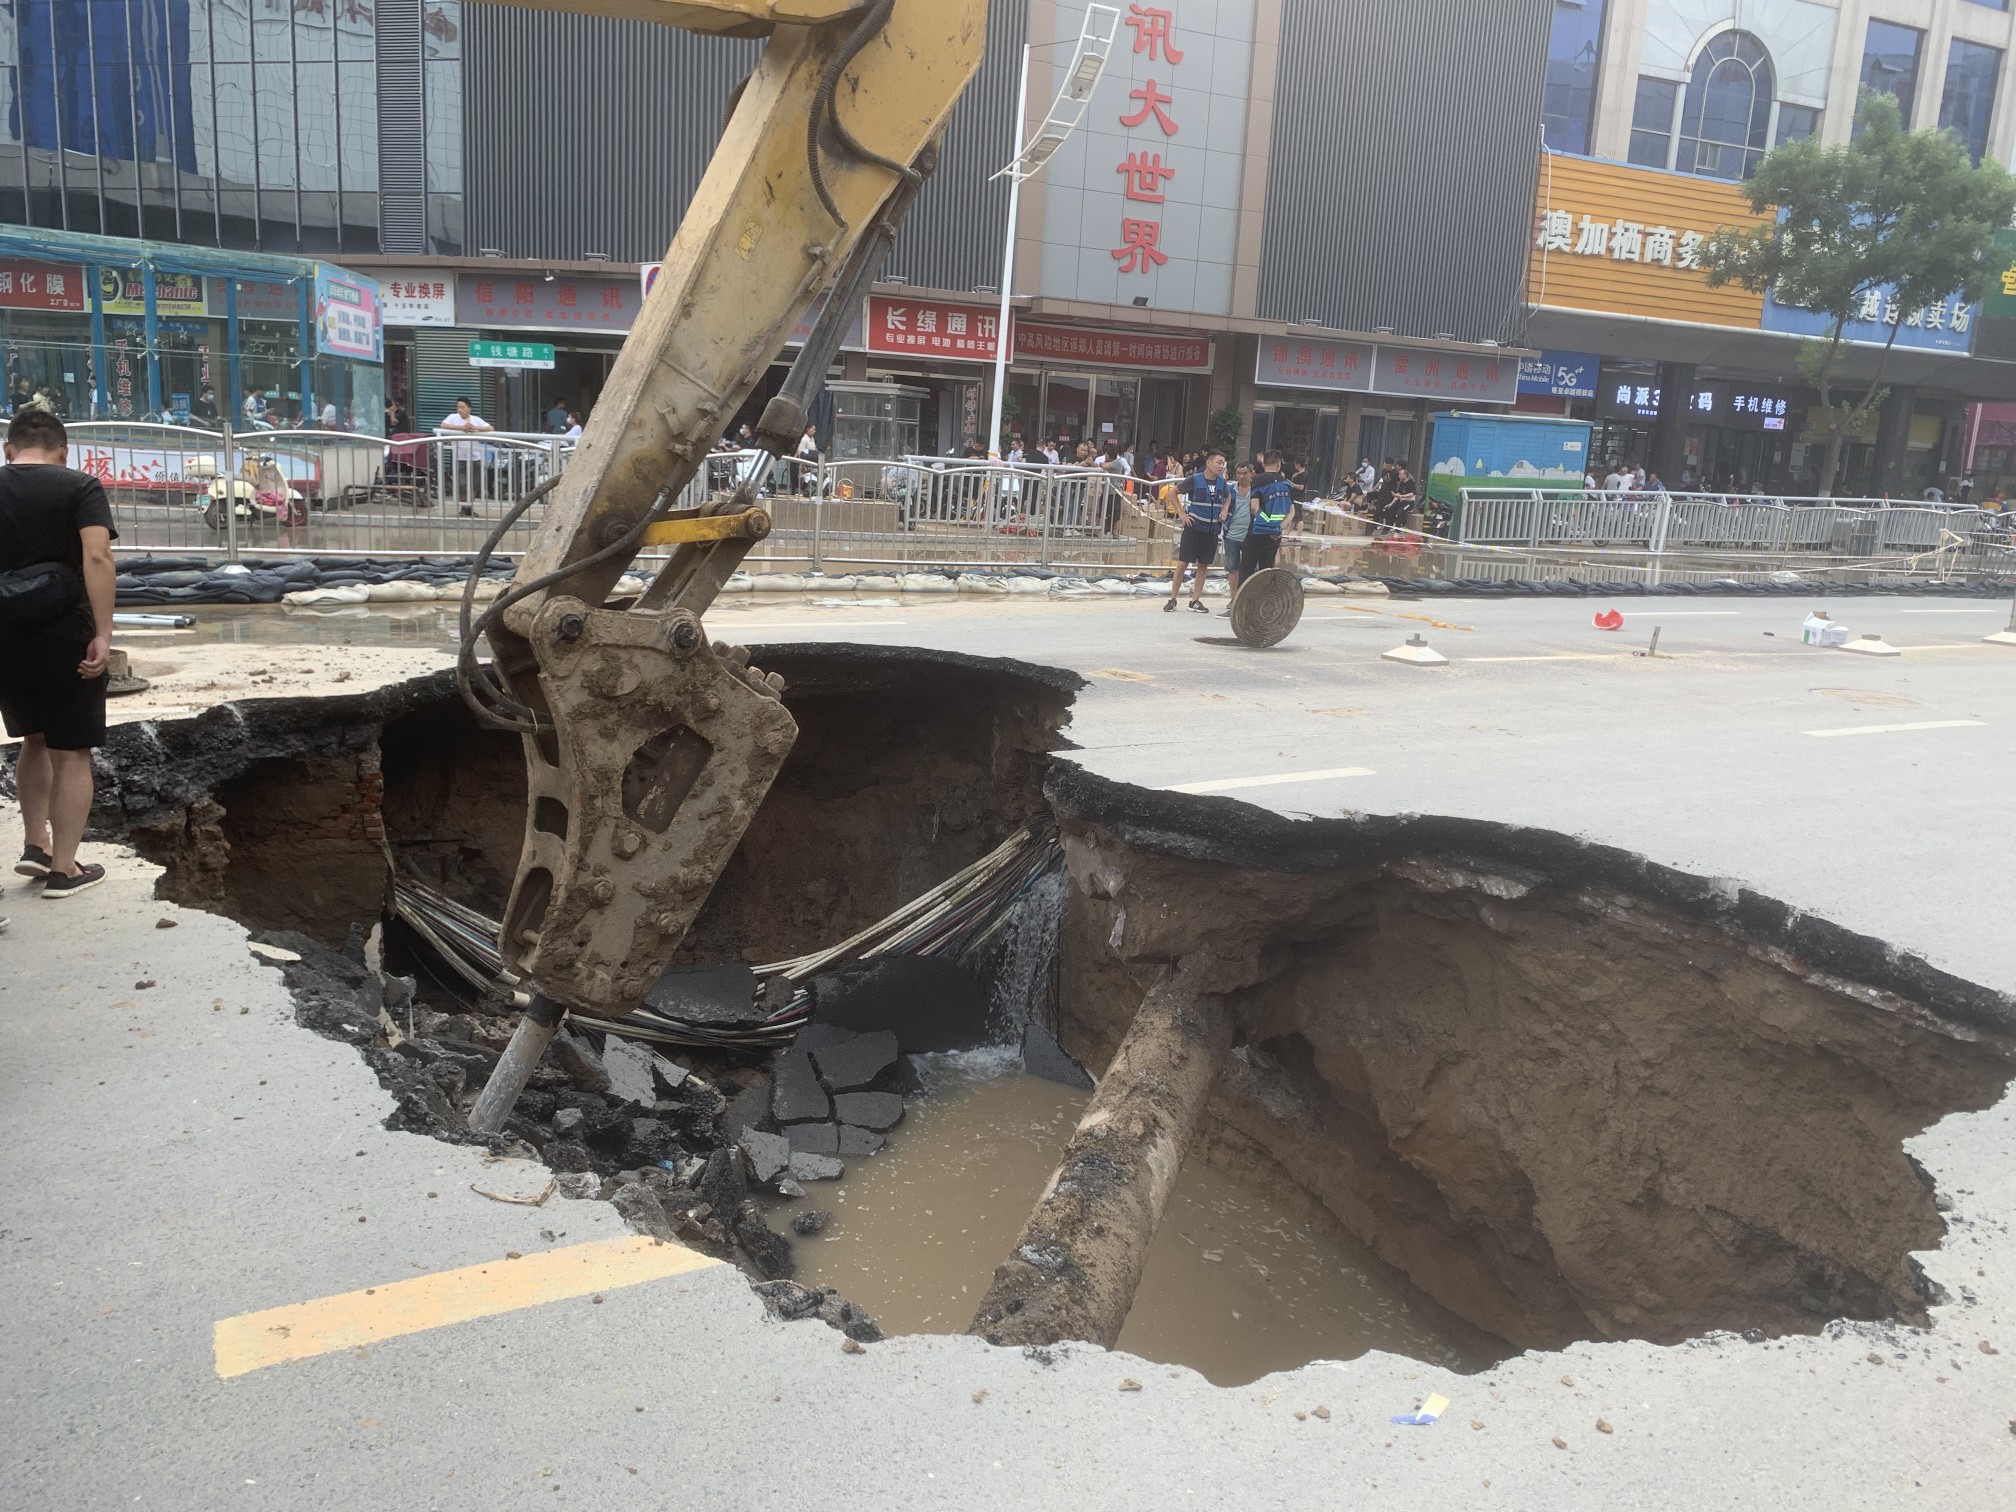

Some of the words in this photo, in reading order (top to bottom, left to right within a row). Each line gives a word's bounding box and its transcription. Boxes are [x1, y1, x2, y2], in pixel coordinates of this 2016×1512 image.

[1111, 3, 1184, 274] 讯大世界
[125, 282, 198, 300] Mehanic
[389, 281, 446, 300] 专业换屏
[885, 305, 997, 339] 长缘通讯
[884, 332, 927, 346] 专业换屏
[931, 336, 952, 349] 电池
[489, 345, 534, 359] 钱塘路
[115, 339, 134, 418] 手机维修
[1733, 395, 1788, 417] 手机维修
